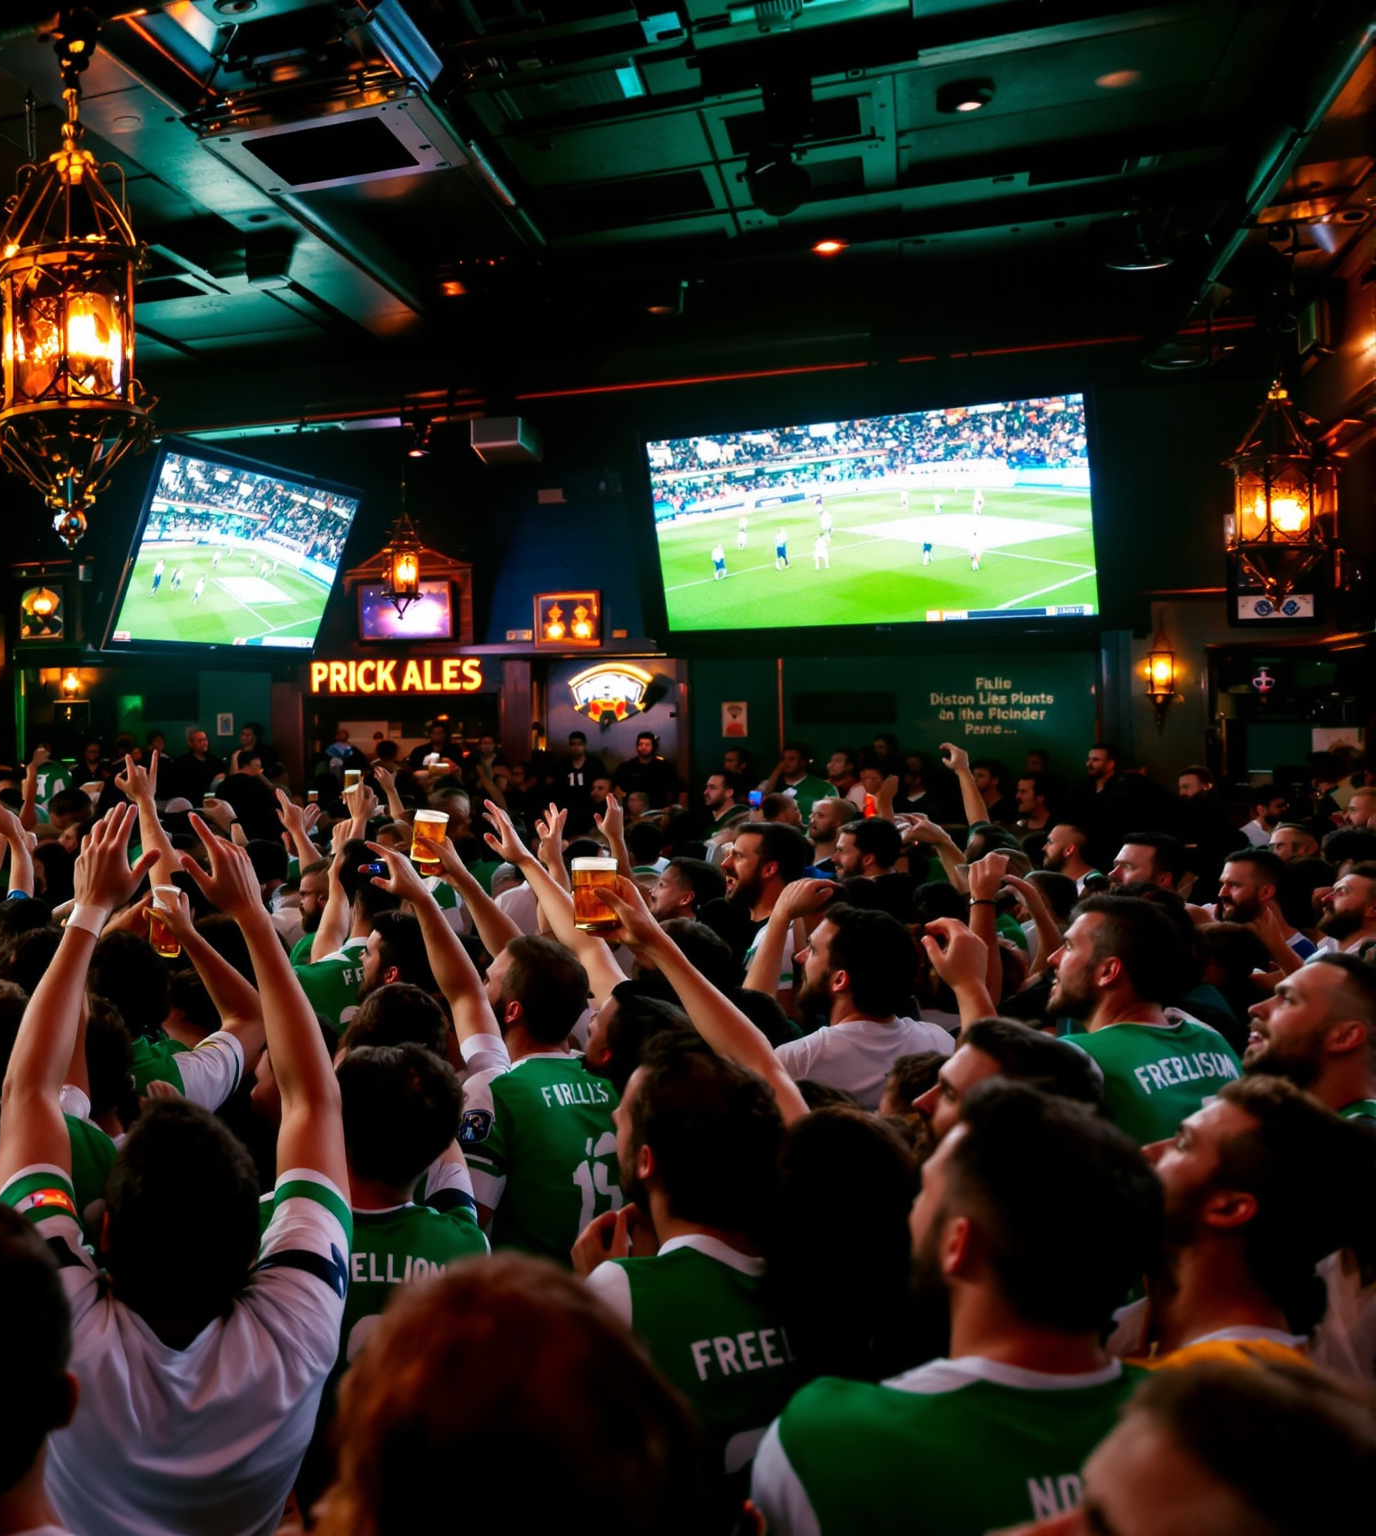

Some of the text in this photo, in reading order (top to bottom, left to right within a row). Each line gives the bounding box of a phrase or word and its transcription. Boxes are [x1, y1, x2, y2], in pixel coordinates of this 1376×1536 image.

[311, 659, 482, 693] PRICK ALES
[567, 771, 585, 787] 11
